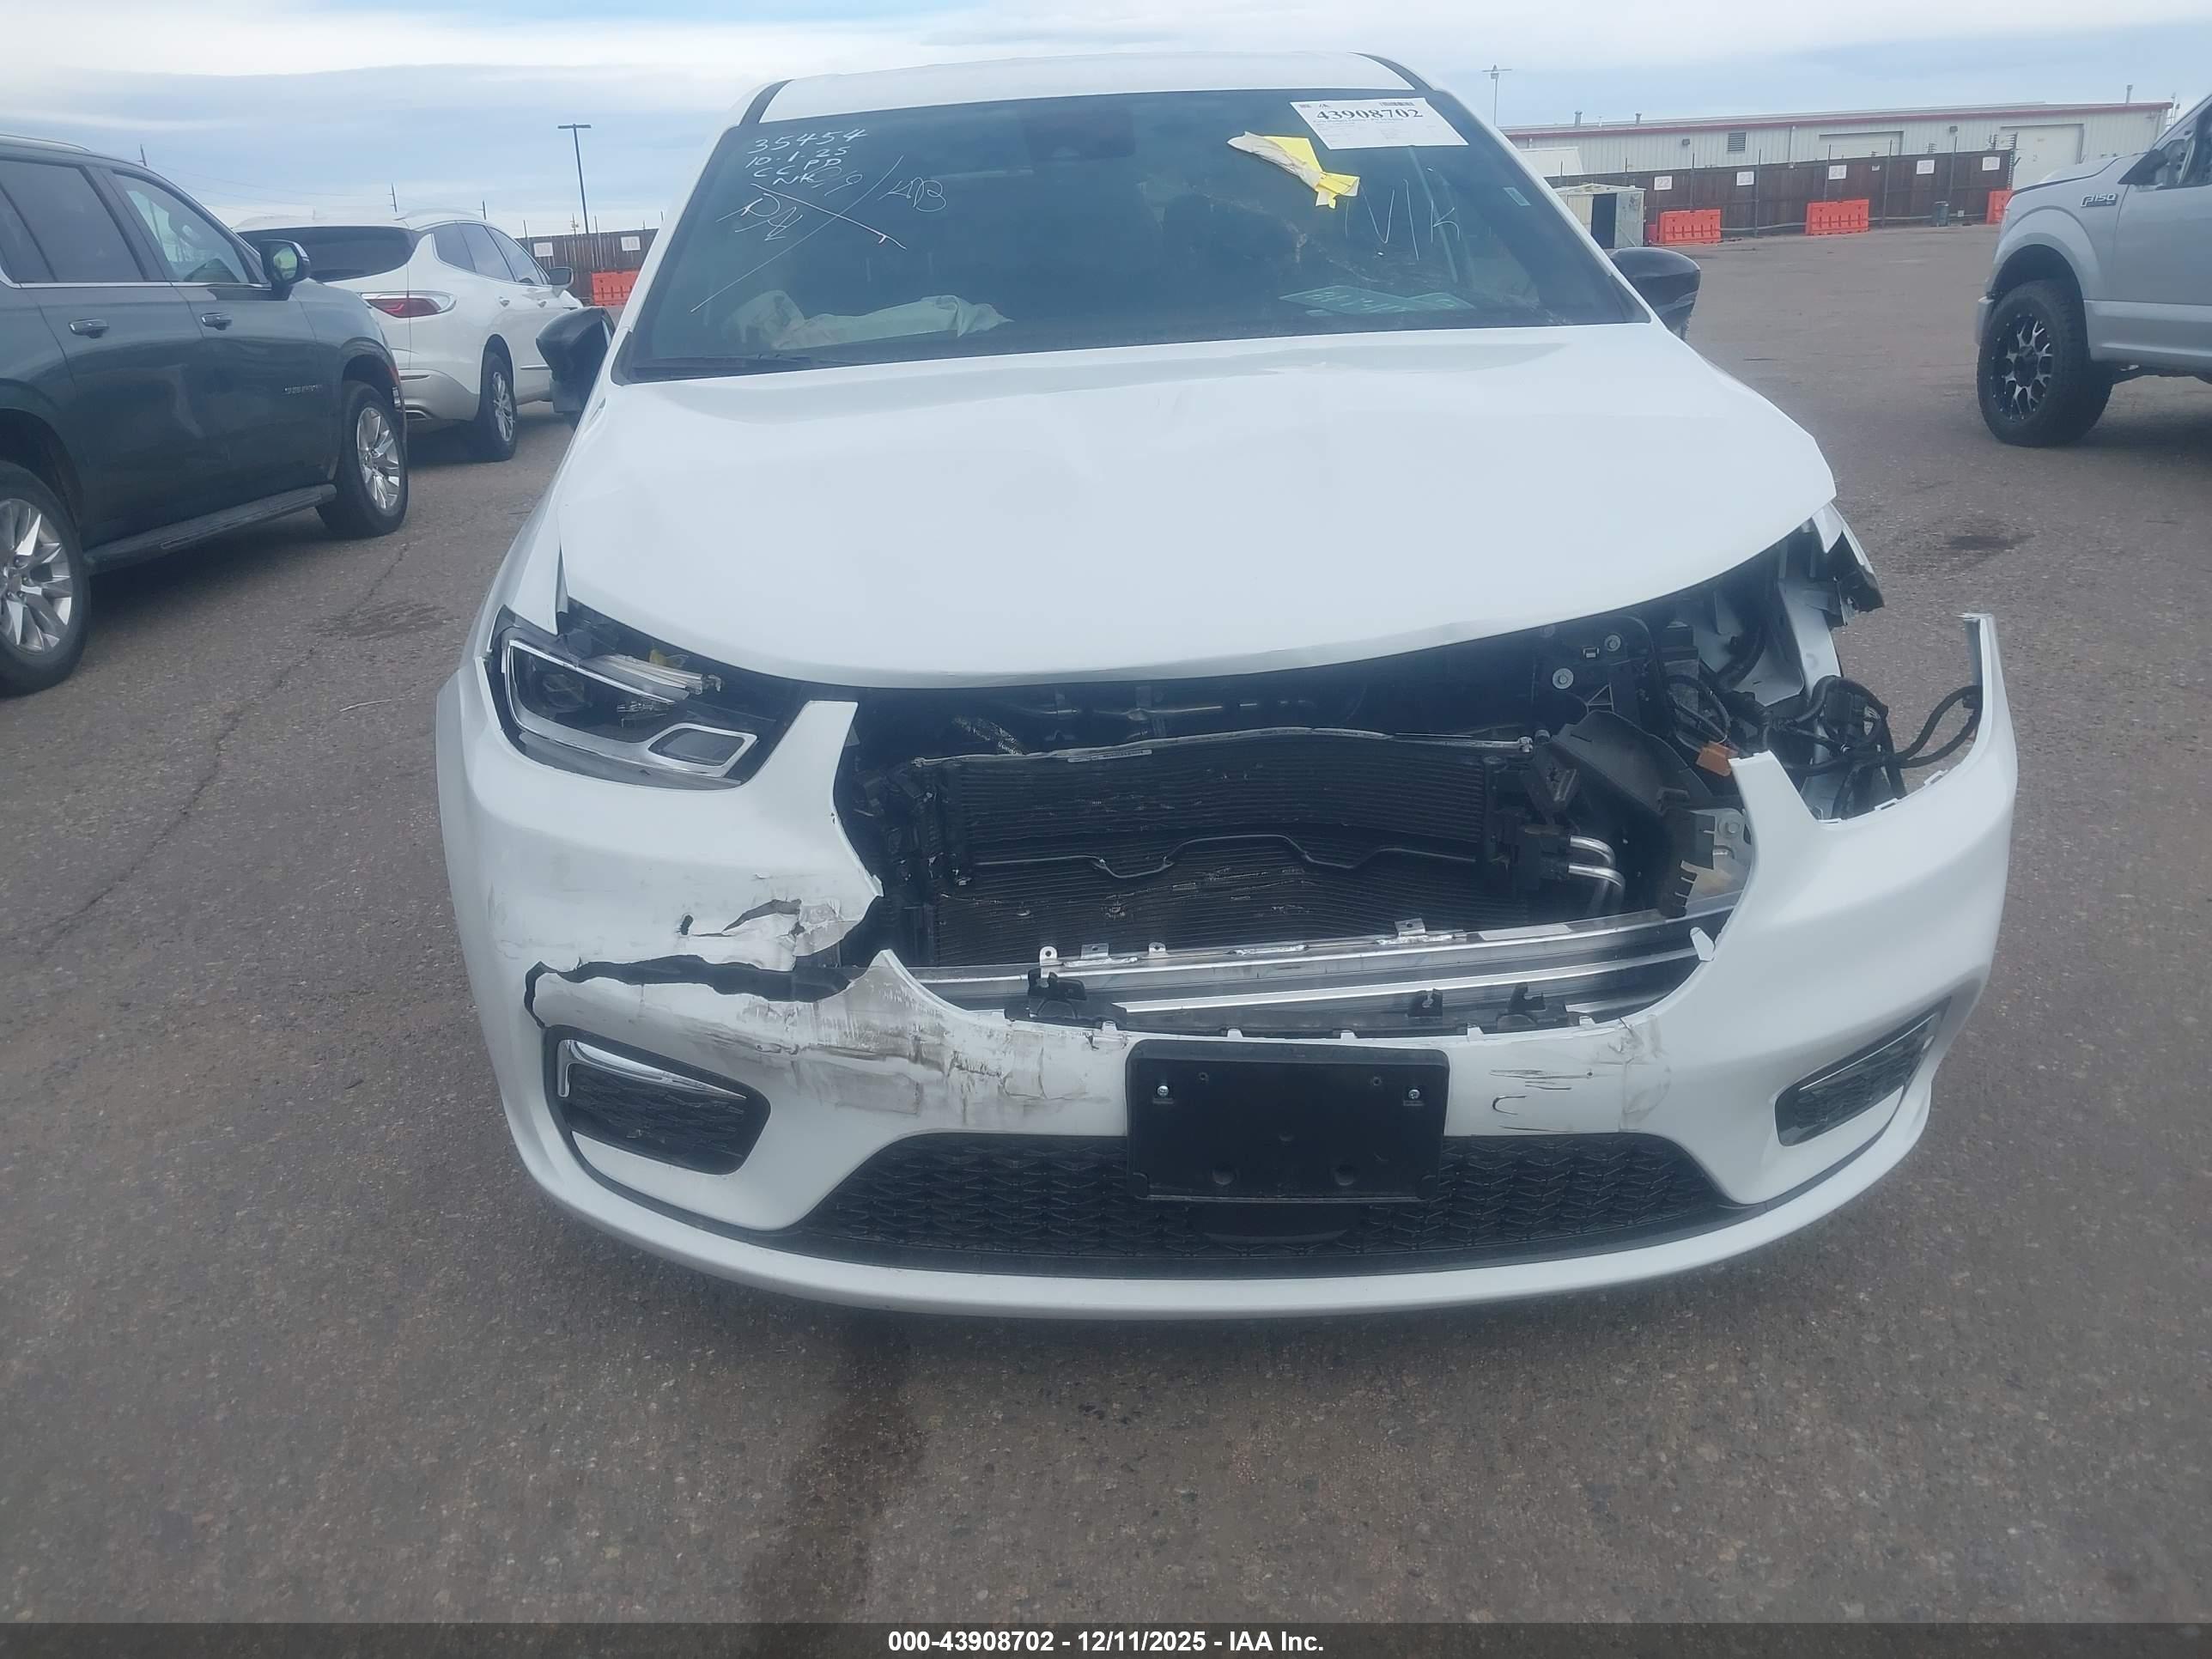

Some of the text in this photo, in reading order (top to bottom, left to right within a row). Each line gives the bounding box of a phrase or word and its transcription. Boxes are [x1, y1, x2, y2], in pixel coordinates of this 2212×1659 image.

[1316, 108, 1424, 119] 43908702
[746, 129, 869, 155] 35454
[1656, 178, 1670, 188] 22
